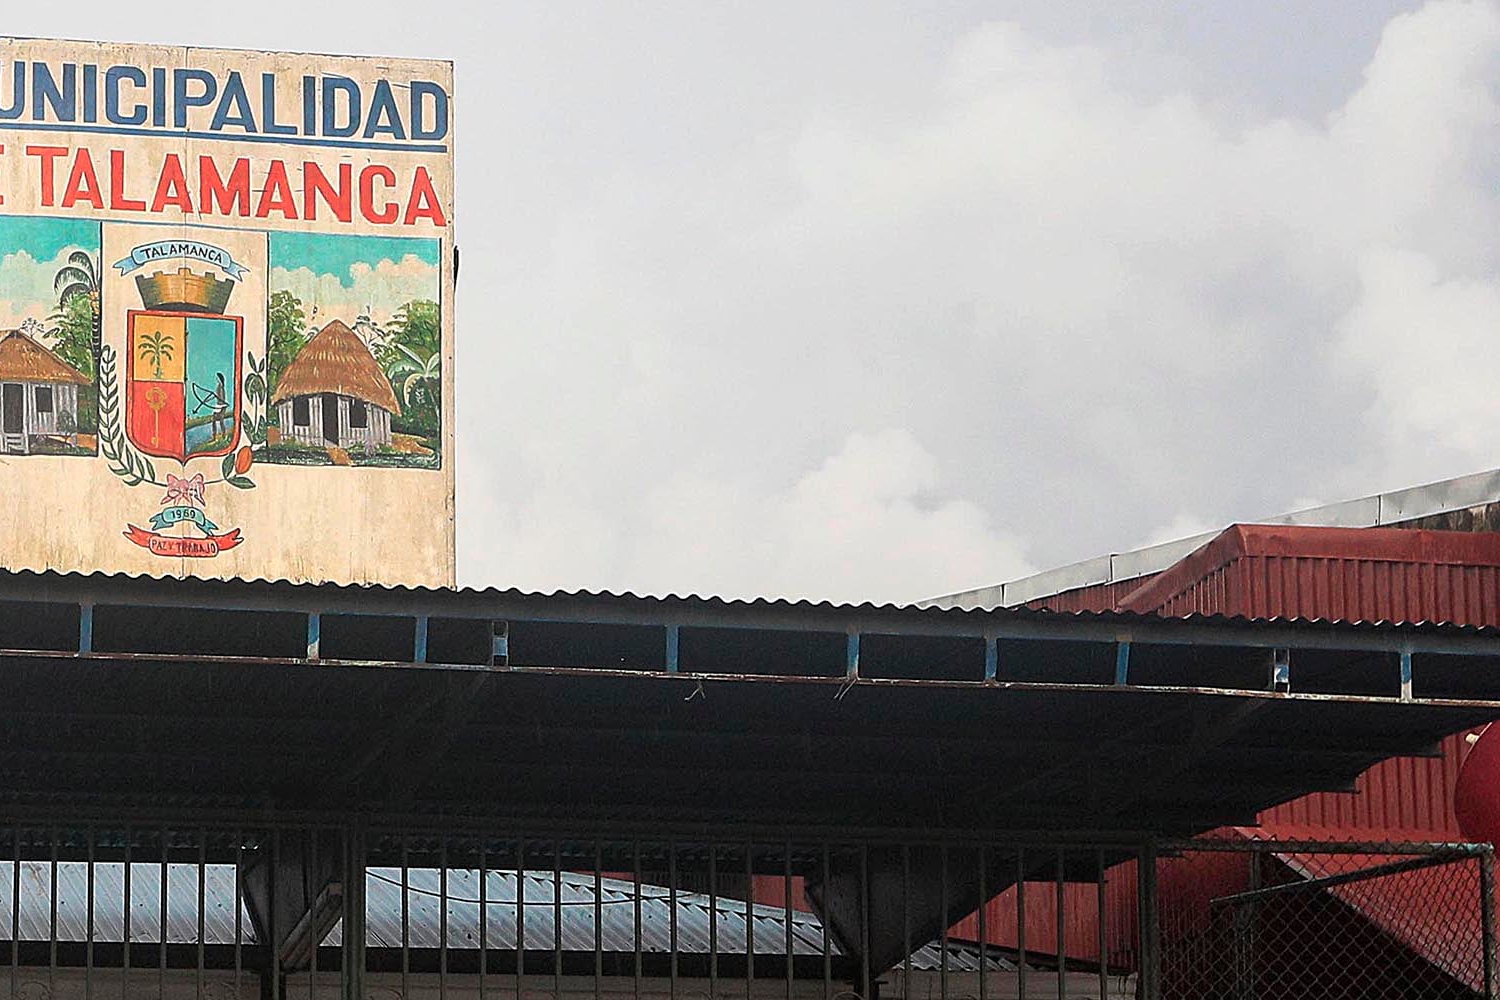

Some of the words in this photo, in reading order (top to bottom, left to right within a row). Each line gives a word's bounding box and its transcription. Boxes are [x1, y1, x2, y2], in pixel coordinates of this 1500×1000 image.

[26, 145, 447, 228] TALAMANCA
[140, 243, 223, 264] TALAMANCA
[151, 540, 168, 551] PAZ
